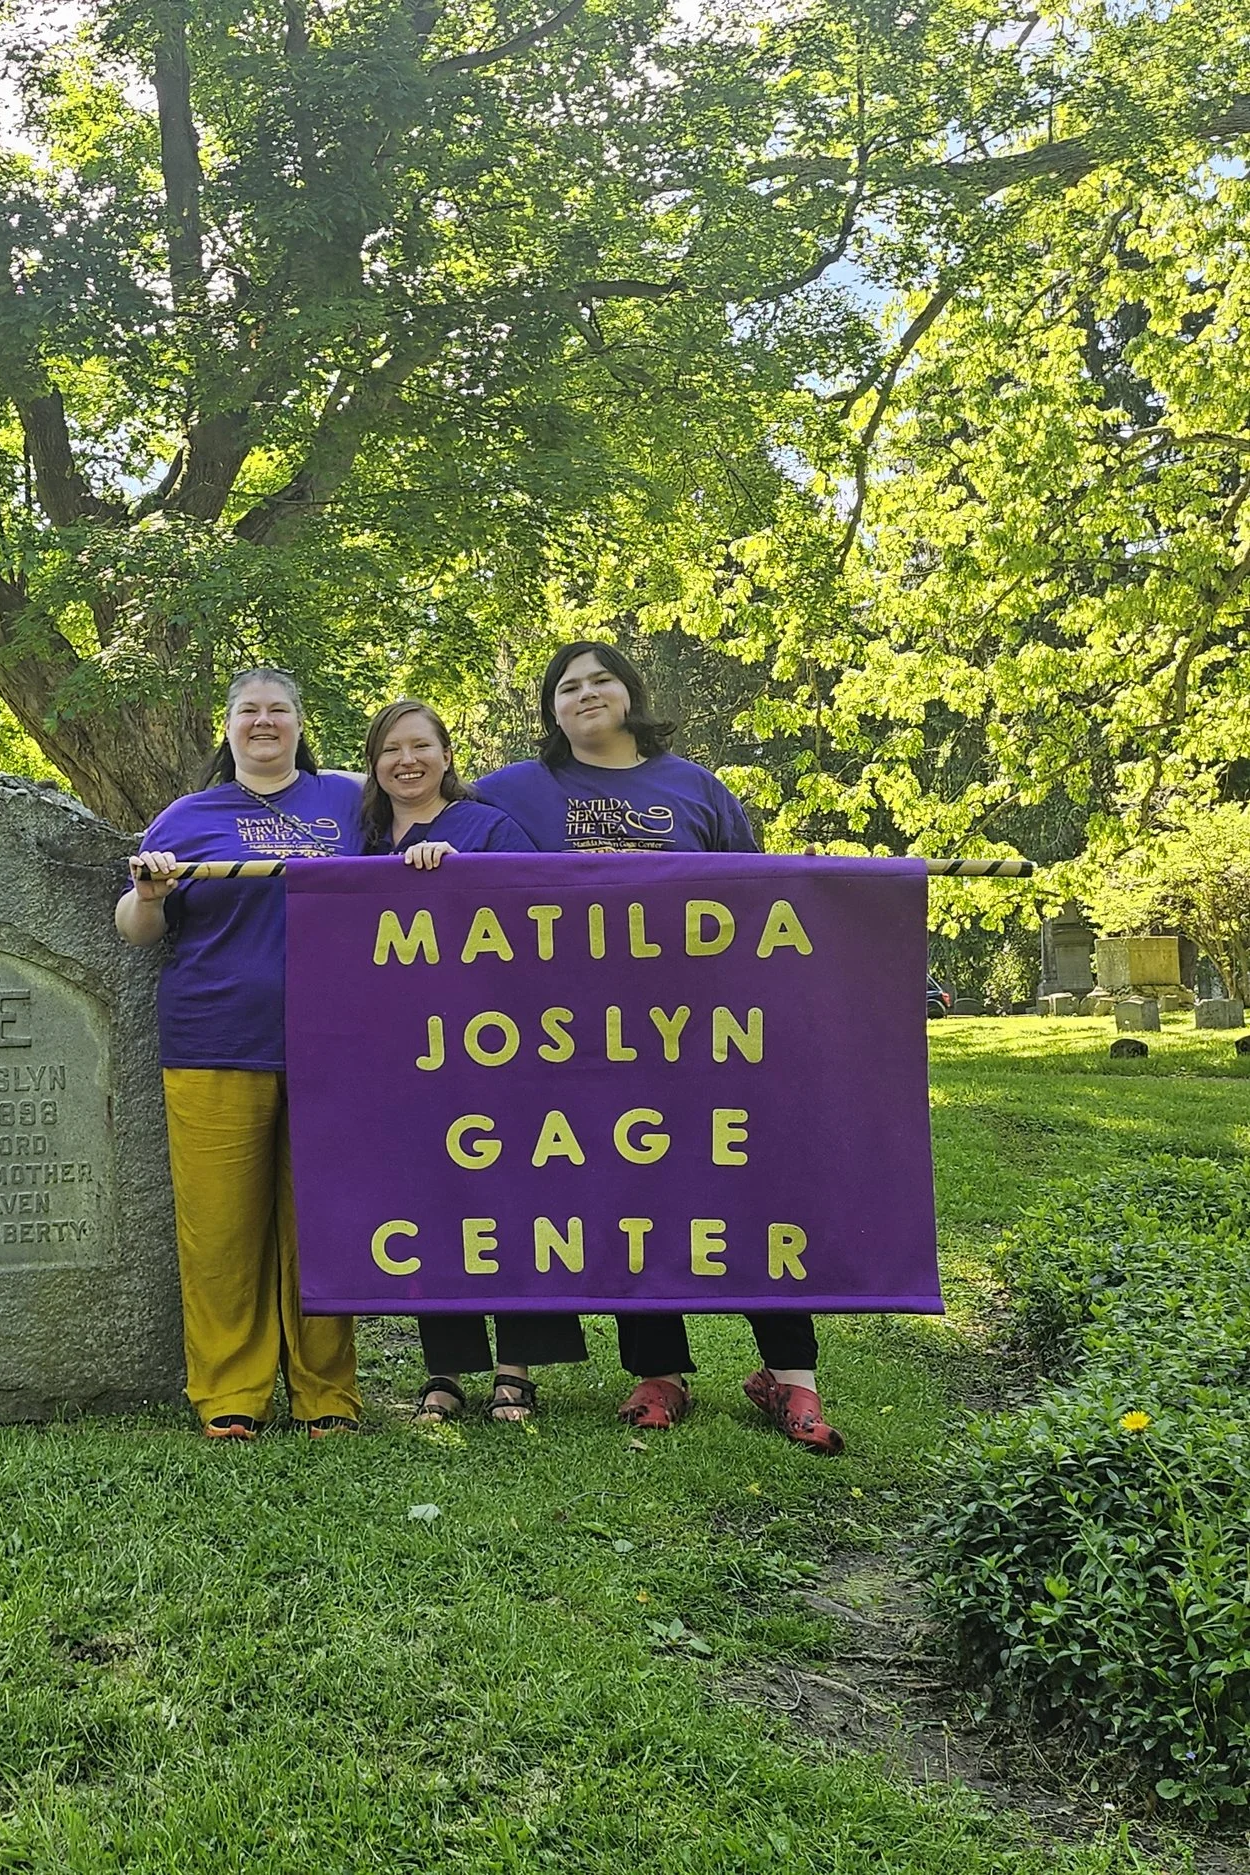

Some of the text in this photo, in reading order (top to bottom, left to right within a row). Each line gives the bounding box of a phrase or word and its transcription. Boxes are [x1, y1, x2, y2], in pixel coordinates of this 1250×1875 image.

[567, 797, 632, 812] MATILDA
[566, 810, 622, 822] SERVES
[238, 824, 293, 835] SERVES
[566, 822, 628, 835] THE TEA
[637, 841, 664, 849] Center
[373, 900, 814, 966] MATILDA
[415, 1006, 764, 1072] JOSLYN
[445, 1107, 750, 1171] GAGE
[370, 1216, 809, 1281] CENTER
